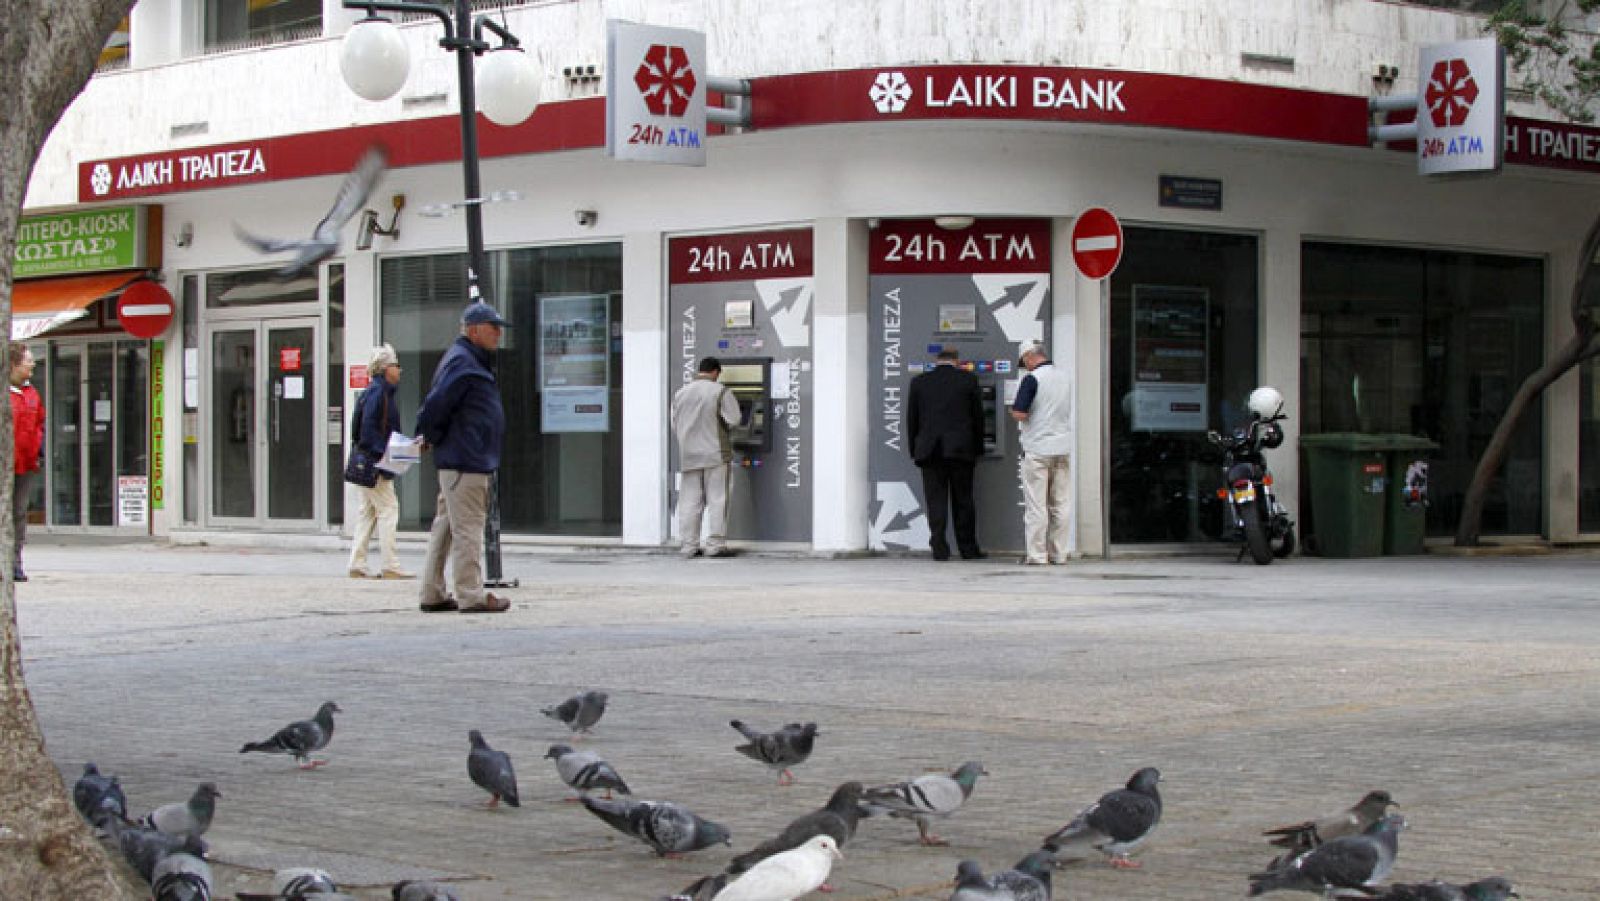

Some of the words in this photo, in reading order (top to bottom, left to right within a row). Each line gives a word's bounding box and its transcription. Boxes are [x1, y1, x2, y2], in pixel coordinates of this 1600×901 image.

[925, 75, 1017, 107] LAIKI
[1032, 76, 1126, 112] BANK
[628, 122, 663, 145] 24h
[667, 125, 700, 148] ATM
[1422, 136, 1444, 159] 24h
[1448, 135, 1484, 155] ATM
[116, 158, 173, 189] ΛΑΙΚΗ
[179, 148, 266, 181] ΤΡΑΠΕΖΑ
[687, 245, 731, 273] 24h
[739, 242, 796, 270] ATM
[884, 233, 946, 262] 24h
[959, 233, 1036, 262] ATM
[682, 304, 697, 384] ΡΑΠΕΖΑ
[883, 287, 901, 380] ΤΡΑΠΕΖΑ
[883, 386, 901, 451] ΛΑΙΚΗ
[786, 437, 801, 488] LAIKI
